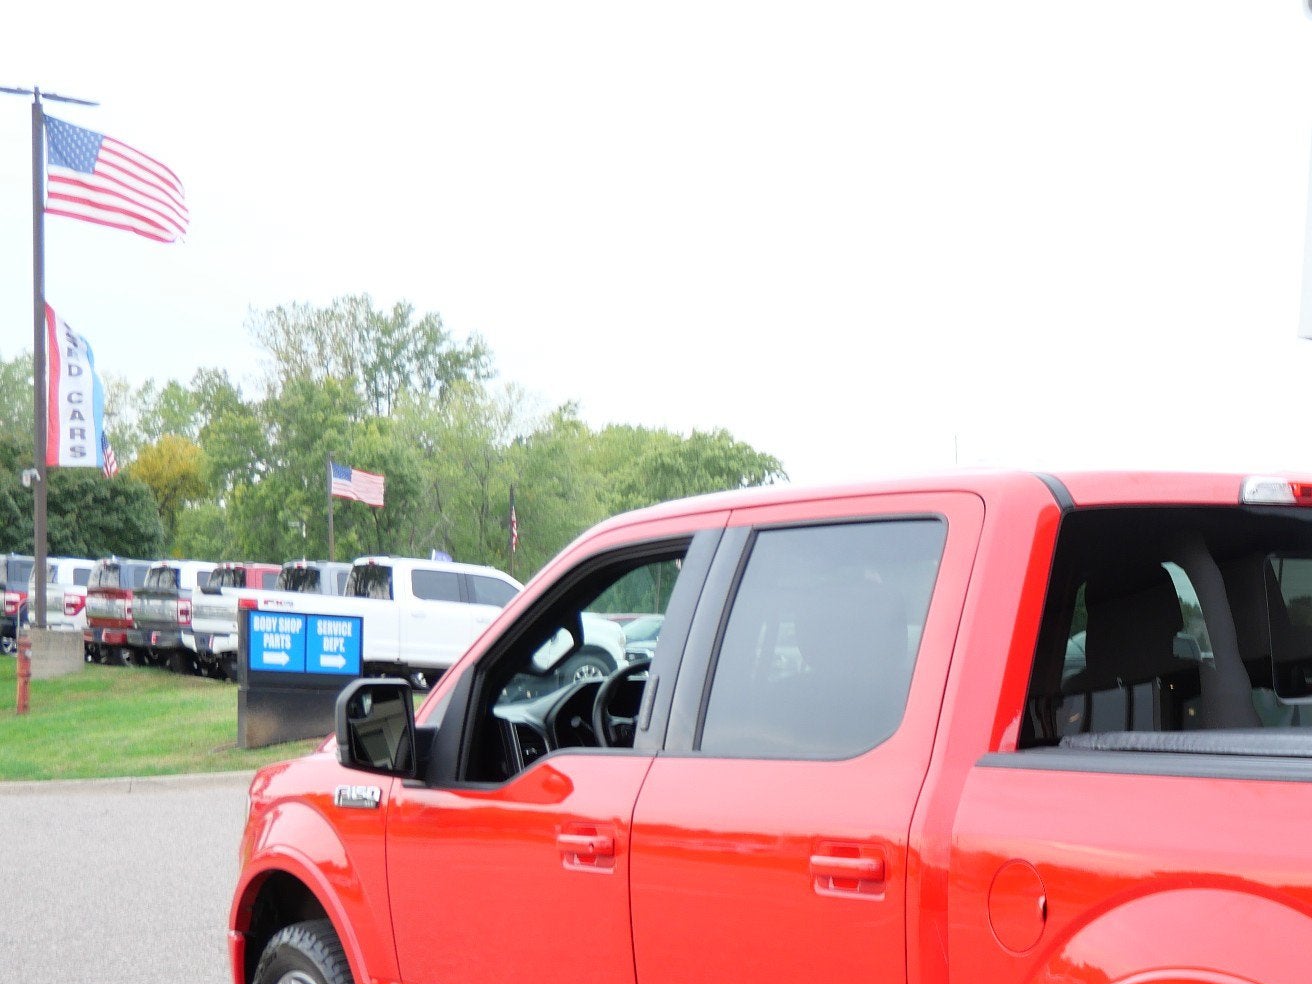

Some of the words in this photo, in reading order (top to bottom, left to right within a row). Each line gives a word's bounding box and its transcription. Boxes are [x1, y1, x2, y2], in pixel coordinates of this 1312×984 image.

[67, 391, 87, 458] CARS
[253, 615, 278, 632] BODY
[278, 617, 302, 634] SHOP
[317, 619, 352, 637] SERVICE
[263, 632, 292, 650] PARTS
[323, 636, 346, 652] DEPT.
